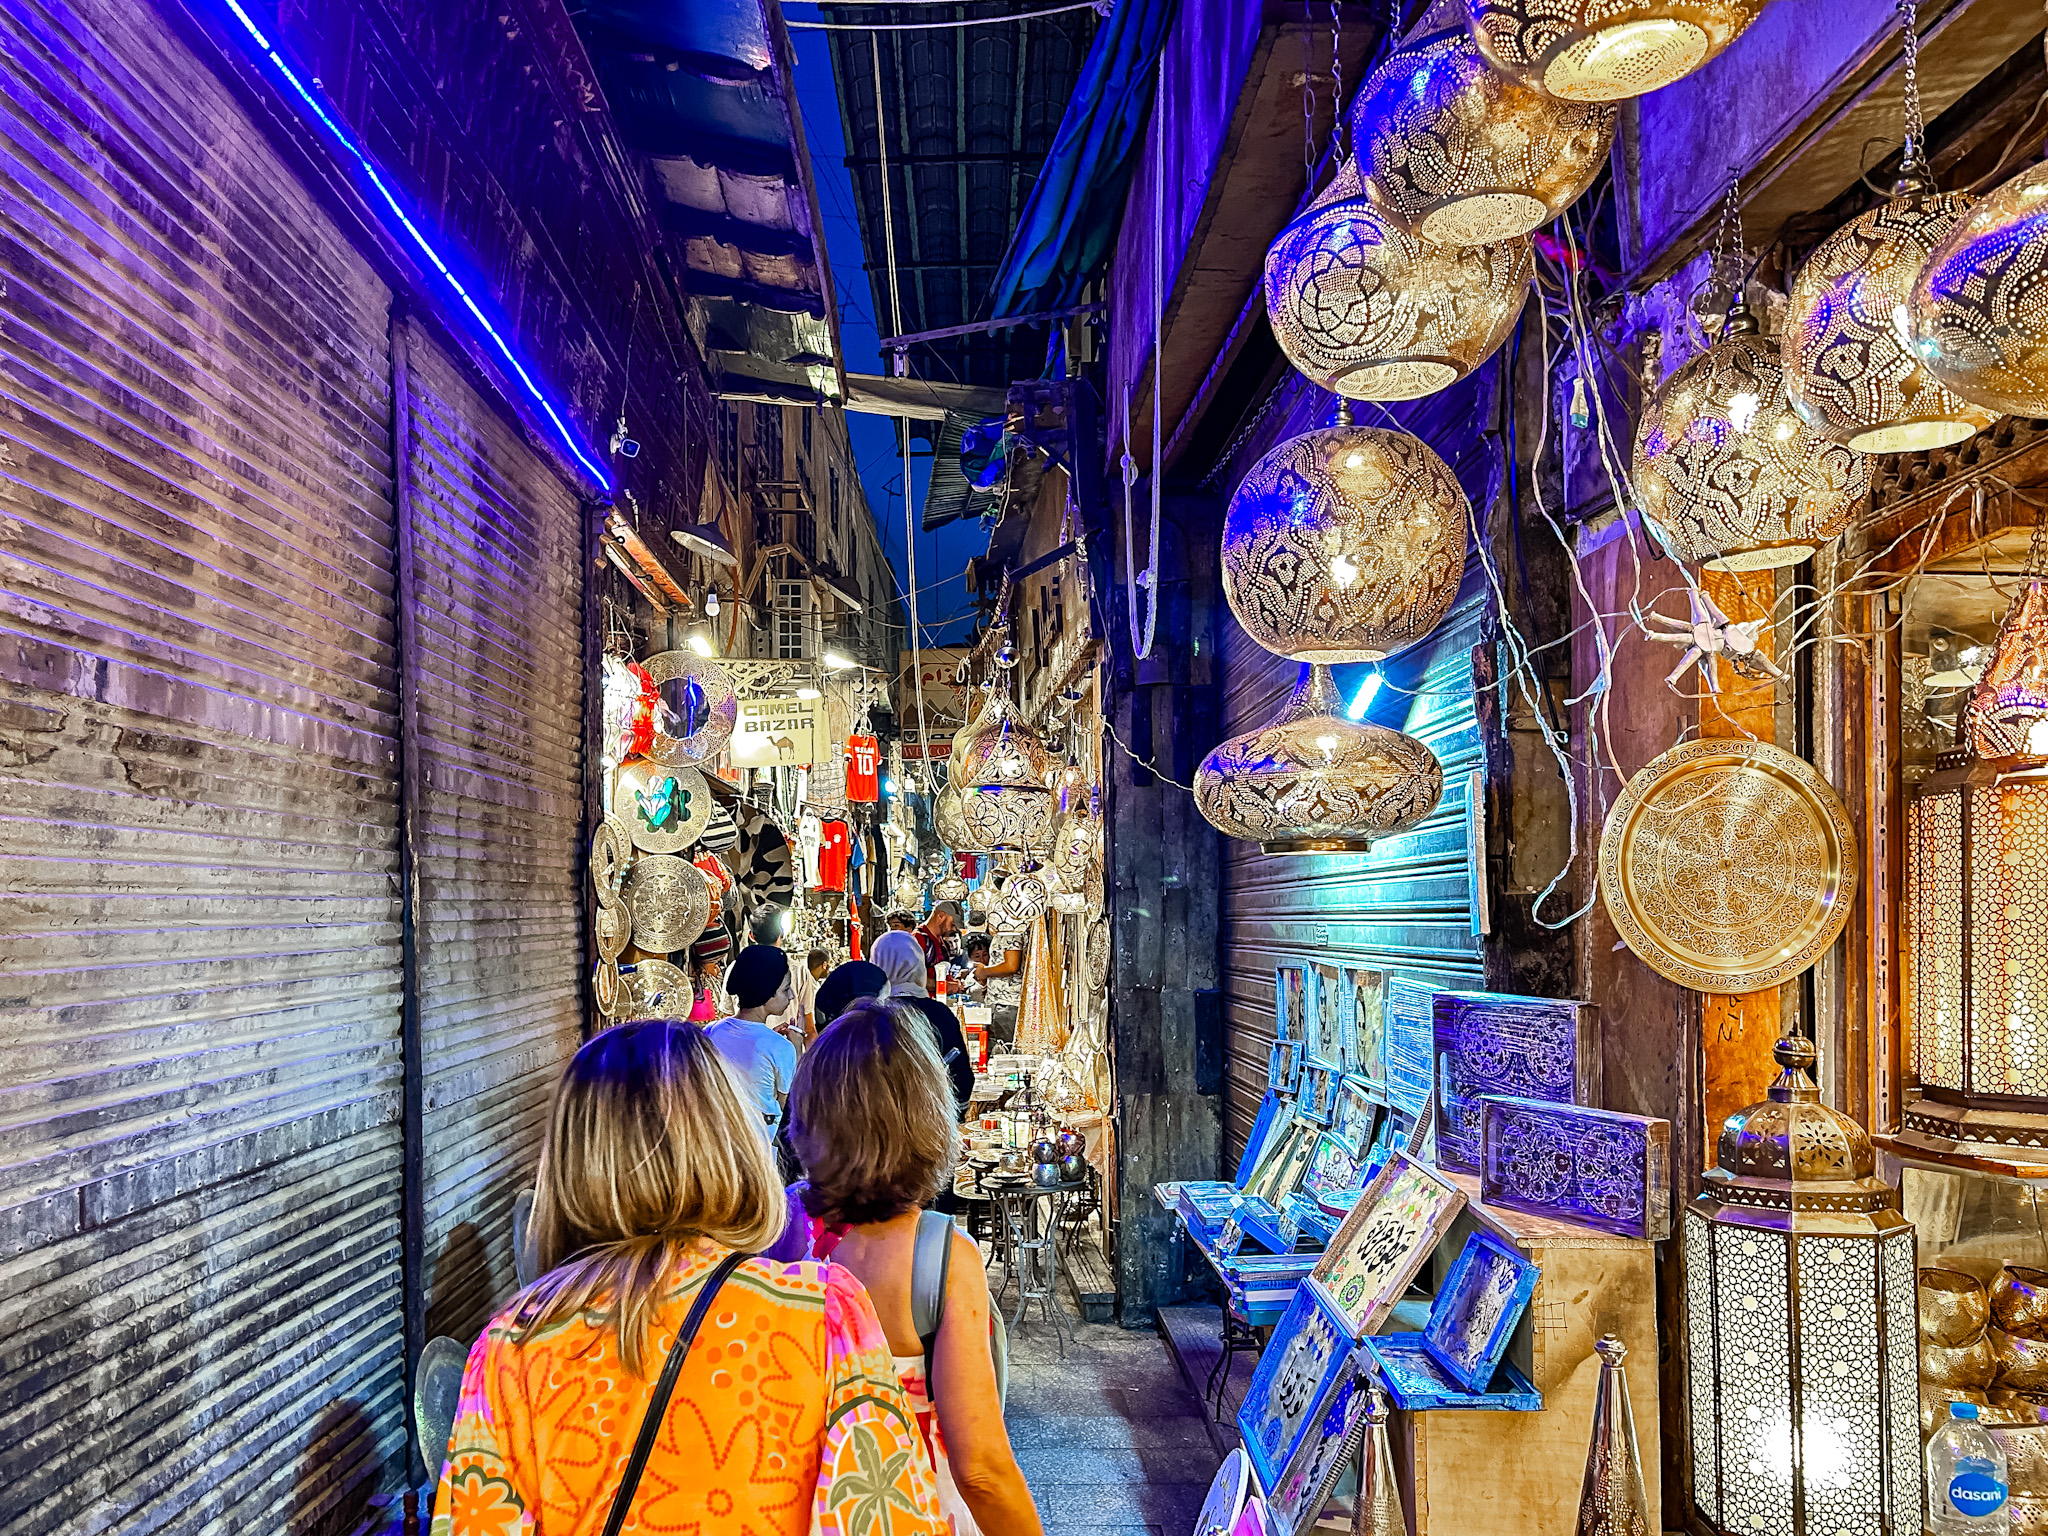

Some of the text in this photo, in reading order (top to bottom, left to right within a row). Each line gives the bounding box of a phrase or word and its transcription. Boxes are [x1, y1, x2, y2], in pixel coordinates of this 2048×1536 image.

[743, 702, 813, 717] CAMEL
[744, 718, 815, 732] BAZAR
[903, 746, 951, 757] WECO
[857, 753, 874, 776] 10
[1951, 1486, 2002, 1501] dasani
